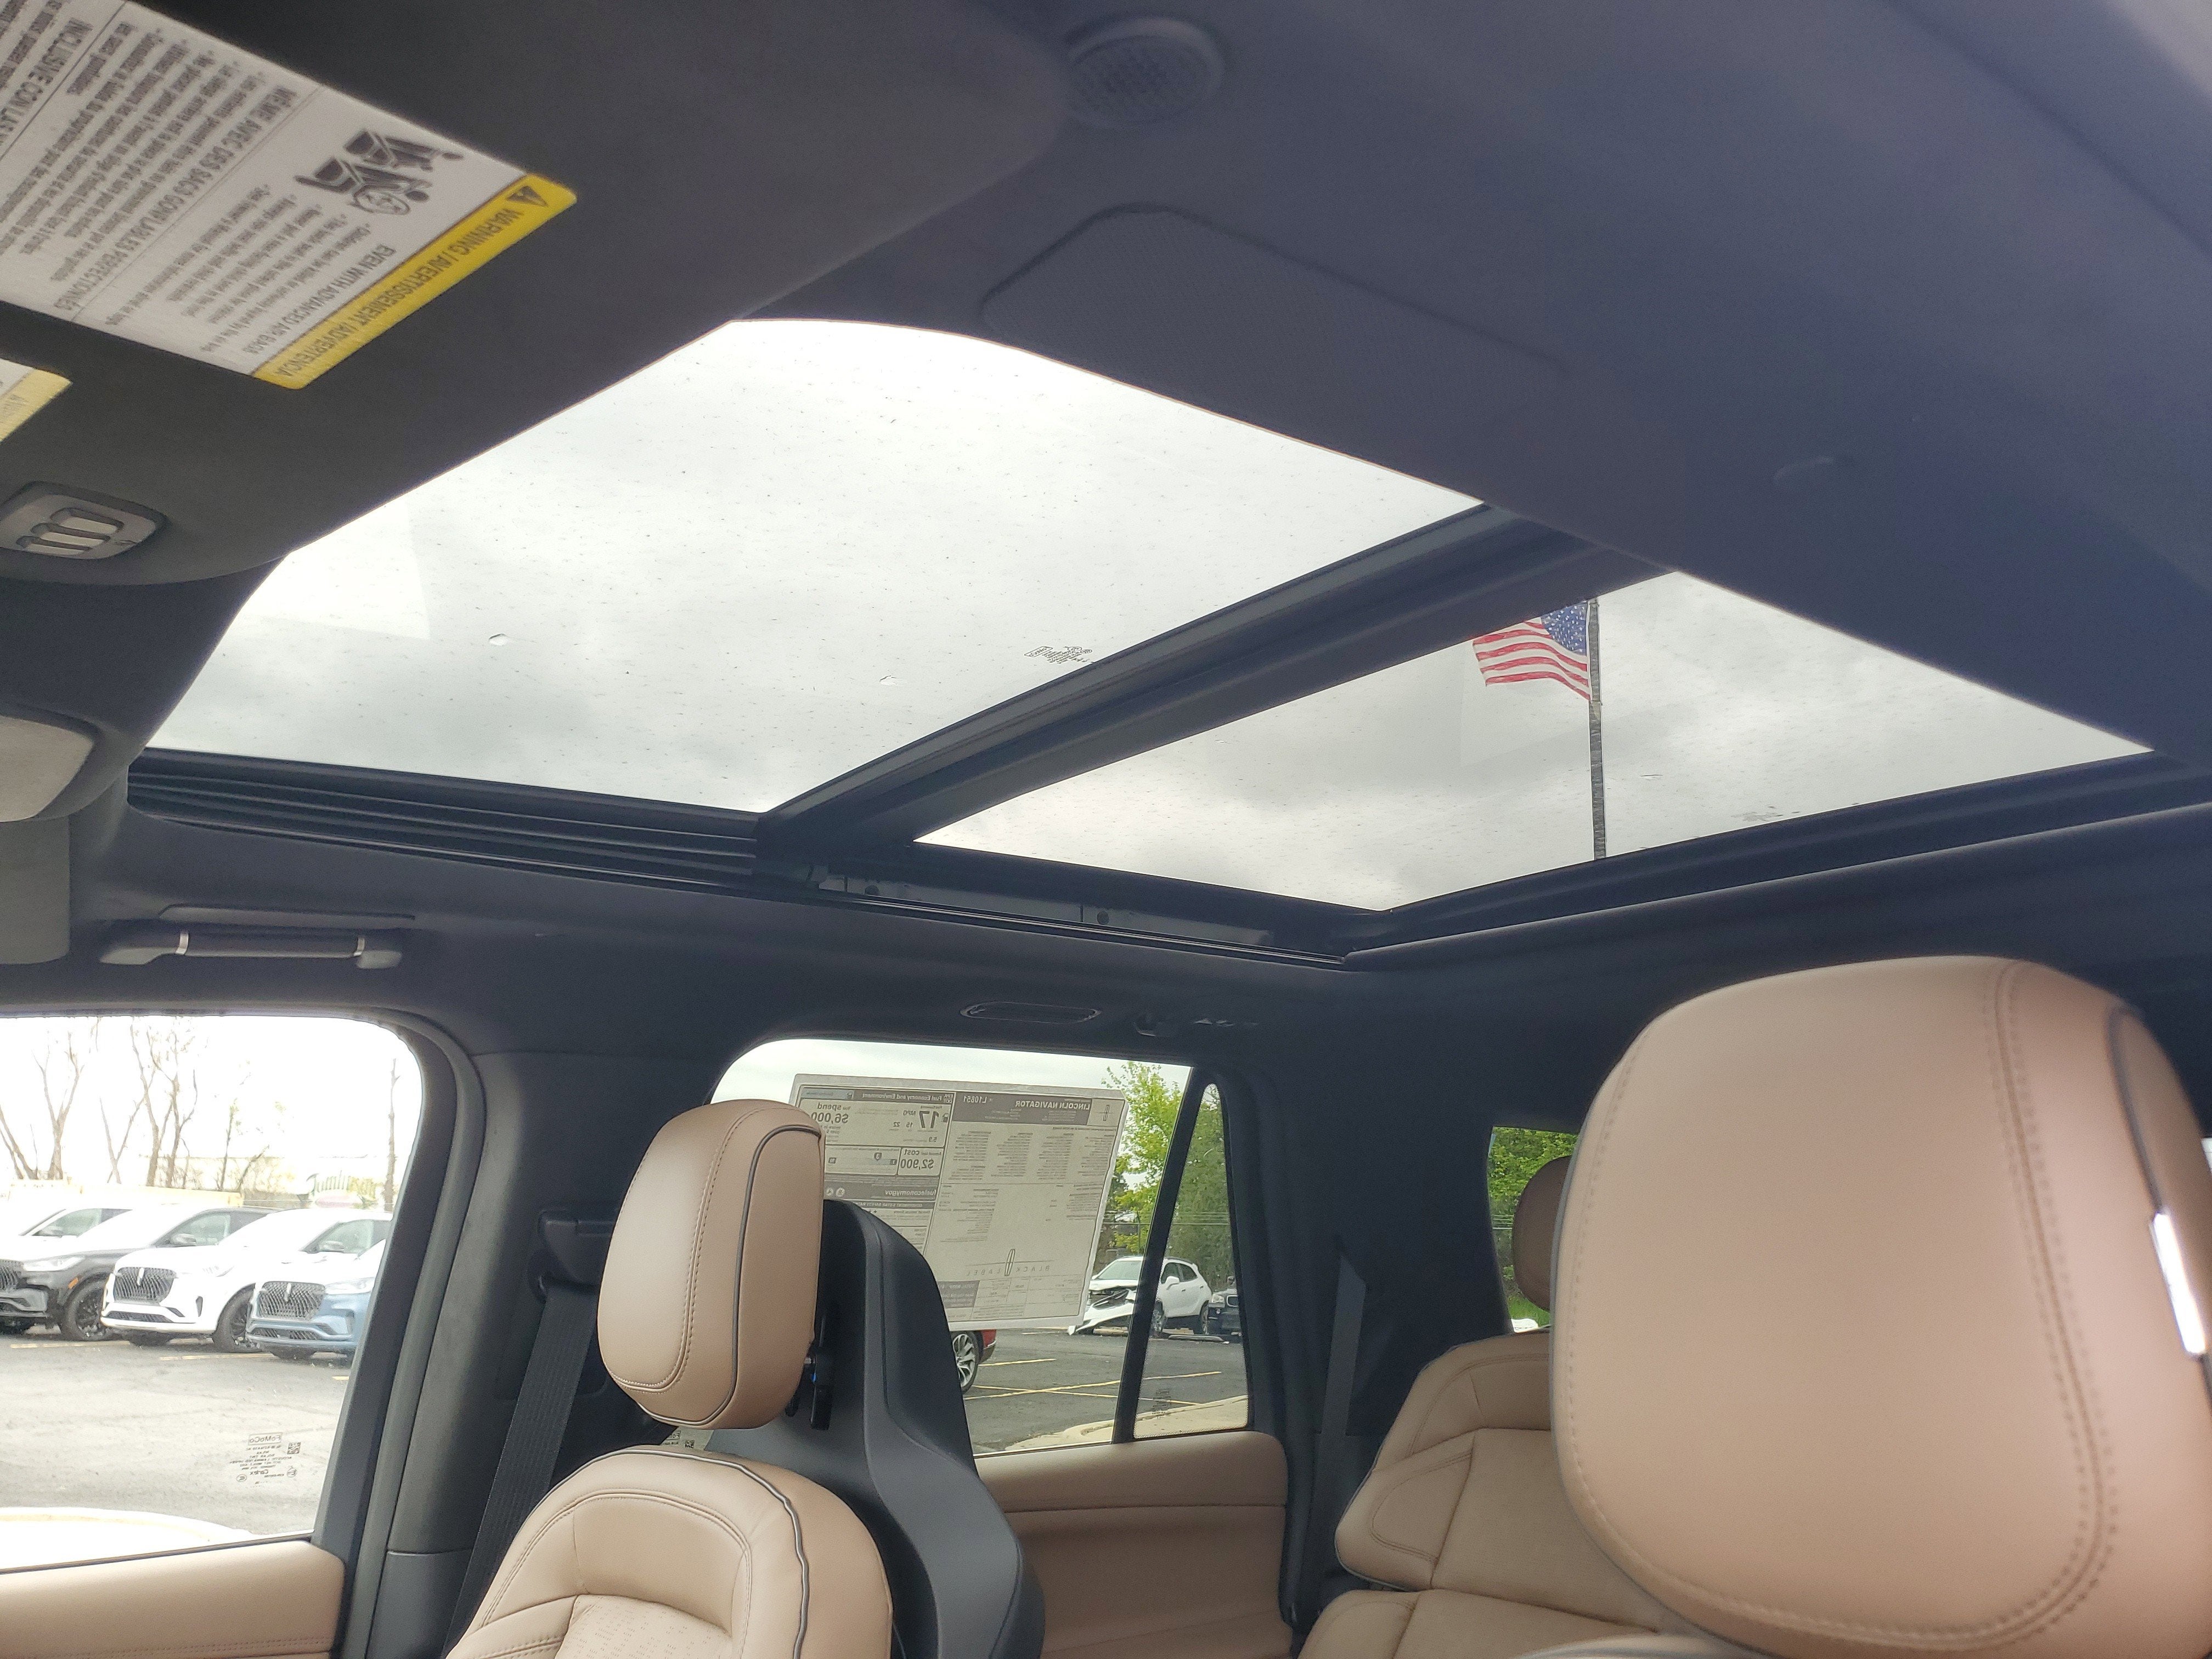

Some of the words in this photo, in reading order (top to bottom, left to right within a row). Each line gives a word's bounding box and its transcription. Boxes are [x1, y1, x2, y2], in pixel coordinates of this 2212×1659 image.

[445, 206, 524, 256] WARNING
[354, 244, 398, 270] EVEN
[328, 265, 369, 290] WITH
[279, 284, 345, 326] ADVANCED
